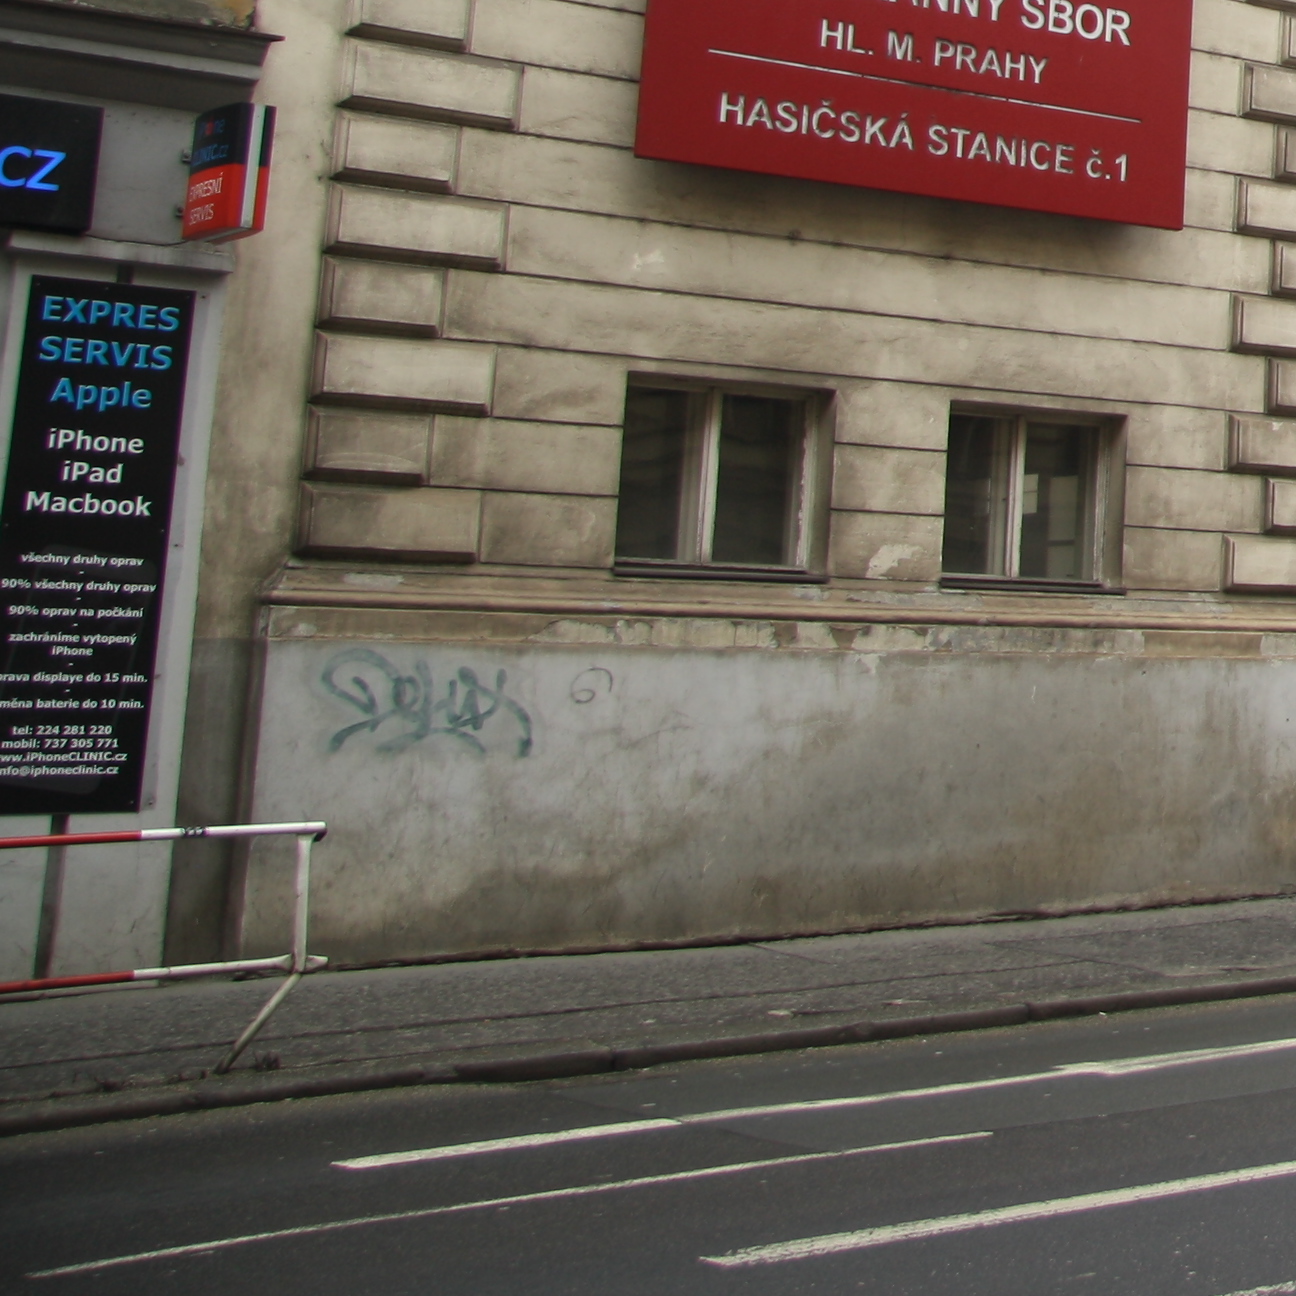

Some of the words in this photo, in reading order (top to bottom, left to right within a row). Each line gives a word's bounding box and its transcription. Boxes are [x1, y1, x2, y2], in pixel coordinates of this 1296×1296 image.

[820, 18, 874, 57] HL.
[886, 30, 922, 64] M.
[933, 38, 1048, 84] PRAHY
[719, 92, 914, 150] HASIČSKÁ
[927, 123, 1075, 175] STANICE
[41, 295, 181, 332] EXPRES
[39, 335, 173, 371] SERVIS
[50, 377, 153, 412] Apple
[48, 428, 145, 454] iPhone
[61, 460, 124, 484] iPad
[26, 490, 152, 517] Macbook
[20, 552, 70, 565] všechny
[73, 554, 108, 567] druhy
[110, 557, 145, 568] oprav
[1, 578, 31, 589] 90%
[34, 579, 83, 592] všechny
[86, 581, 120, 593] druhy
[123, 583, 157, 593] oprav
[8, 605, 39, 616] 90%
[42, 607, 77, 617] oprav
[79, 608, 94, 617] na
[97, 606, 144, 619] počkání
[8, 631, 80, 643] zachráníme
[82, 633, 138, 646] vytopený
[51, 645, 94, 656] iPhone
[33, 671, 83, 684] displaye
[86, 672, 102, 683] do
[105, 672, 120, 683] 15
[122, 673, 148, 683] min.
[0, 697, 33, 709] měna
[36, 698, 80, 709] baterie
[82, 698, 98, 709] do
[101, 698, 117, 709] 10
[119, 698, 145, 709] min.
[12, 725, 33, 735] tel:
[36, 725, 60, 735] 224
[63, 725, 86, 735] 281
[89, 725, 113, 735] 220
[1, 738, 41, 749] mobil:
[44, 738, 68, 748] 737
[70, 738, 94, 748] 305
[97, 738, 119, 749] 771
[0, 751, 128, 762] ww.iPhoneCLINIC.cz
[0, 765, 120, 777] nfo@iphoneclinic.cz
